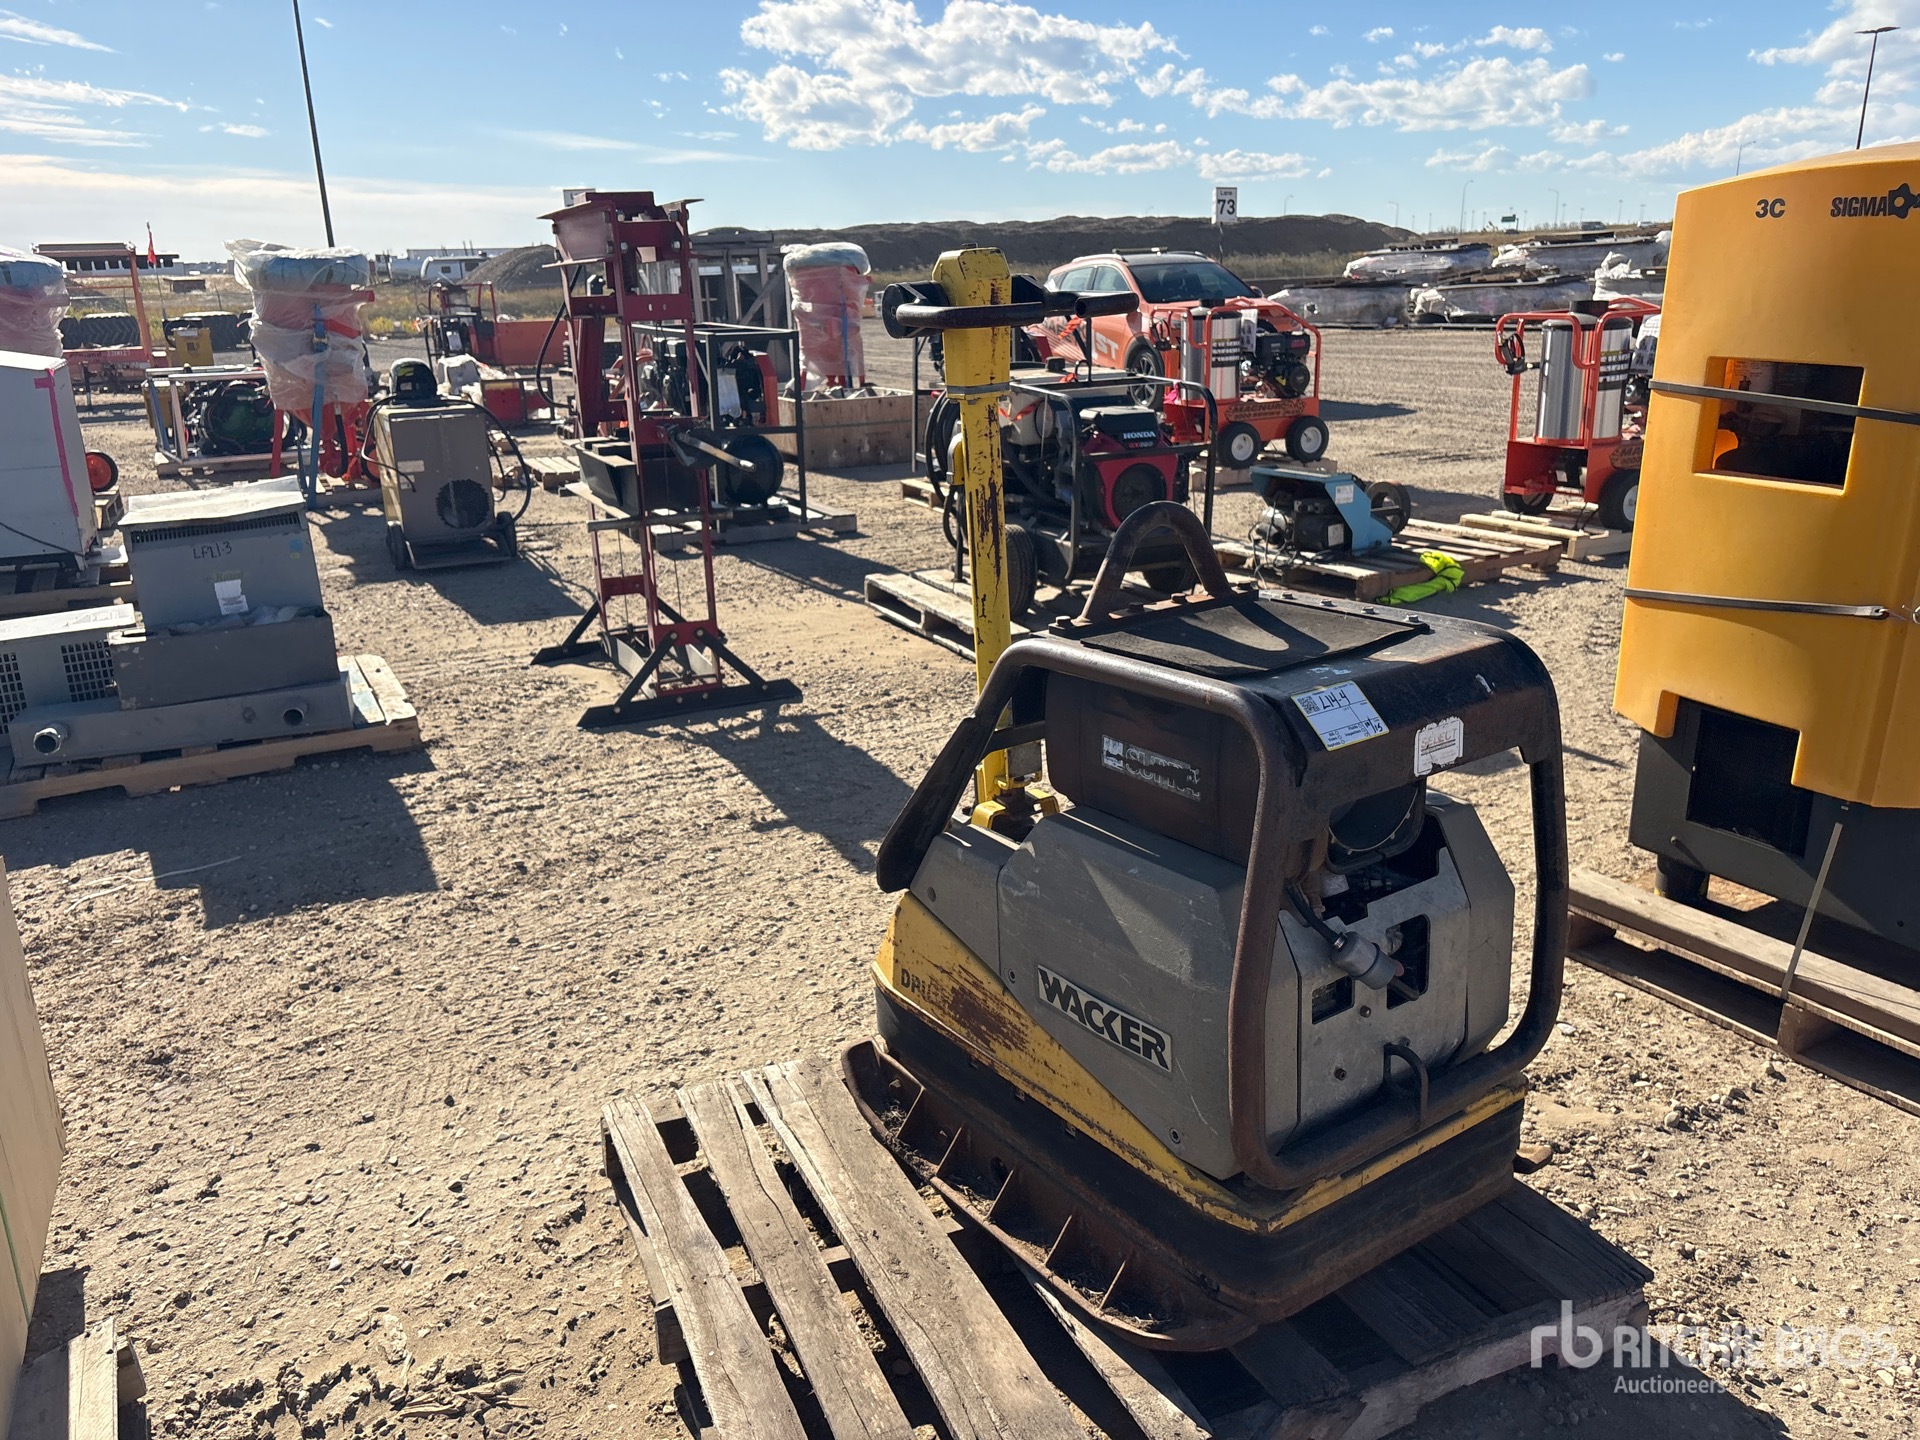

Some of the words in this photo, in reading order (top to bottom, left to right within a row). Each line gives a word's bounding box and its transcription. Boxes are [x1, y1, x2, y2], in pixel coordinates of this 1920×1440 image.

[1217, 199, 1235, 215] 73
[1755, 198, 1786, 218] 3C
[1830, 196, 1888, 217] SIGMA
[1123, 431, 1156, 439] HONDA
[1319, 689, 1350, 710] L14-4
[1038, 969, 1170, 1071] WACKER
